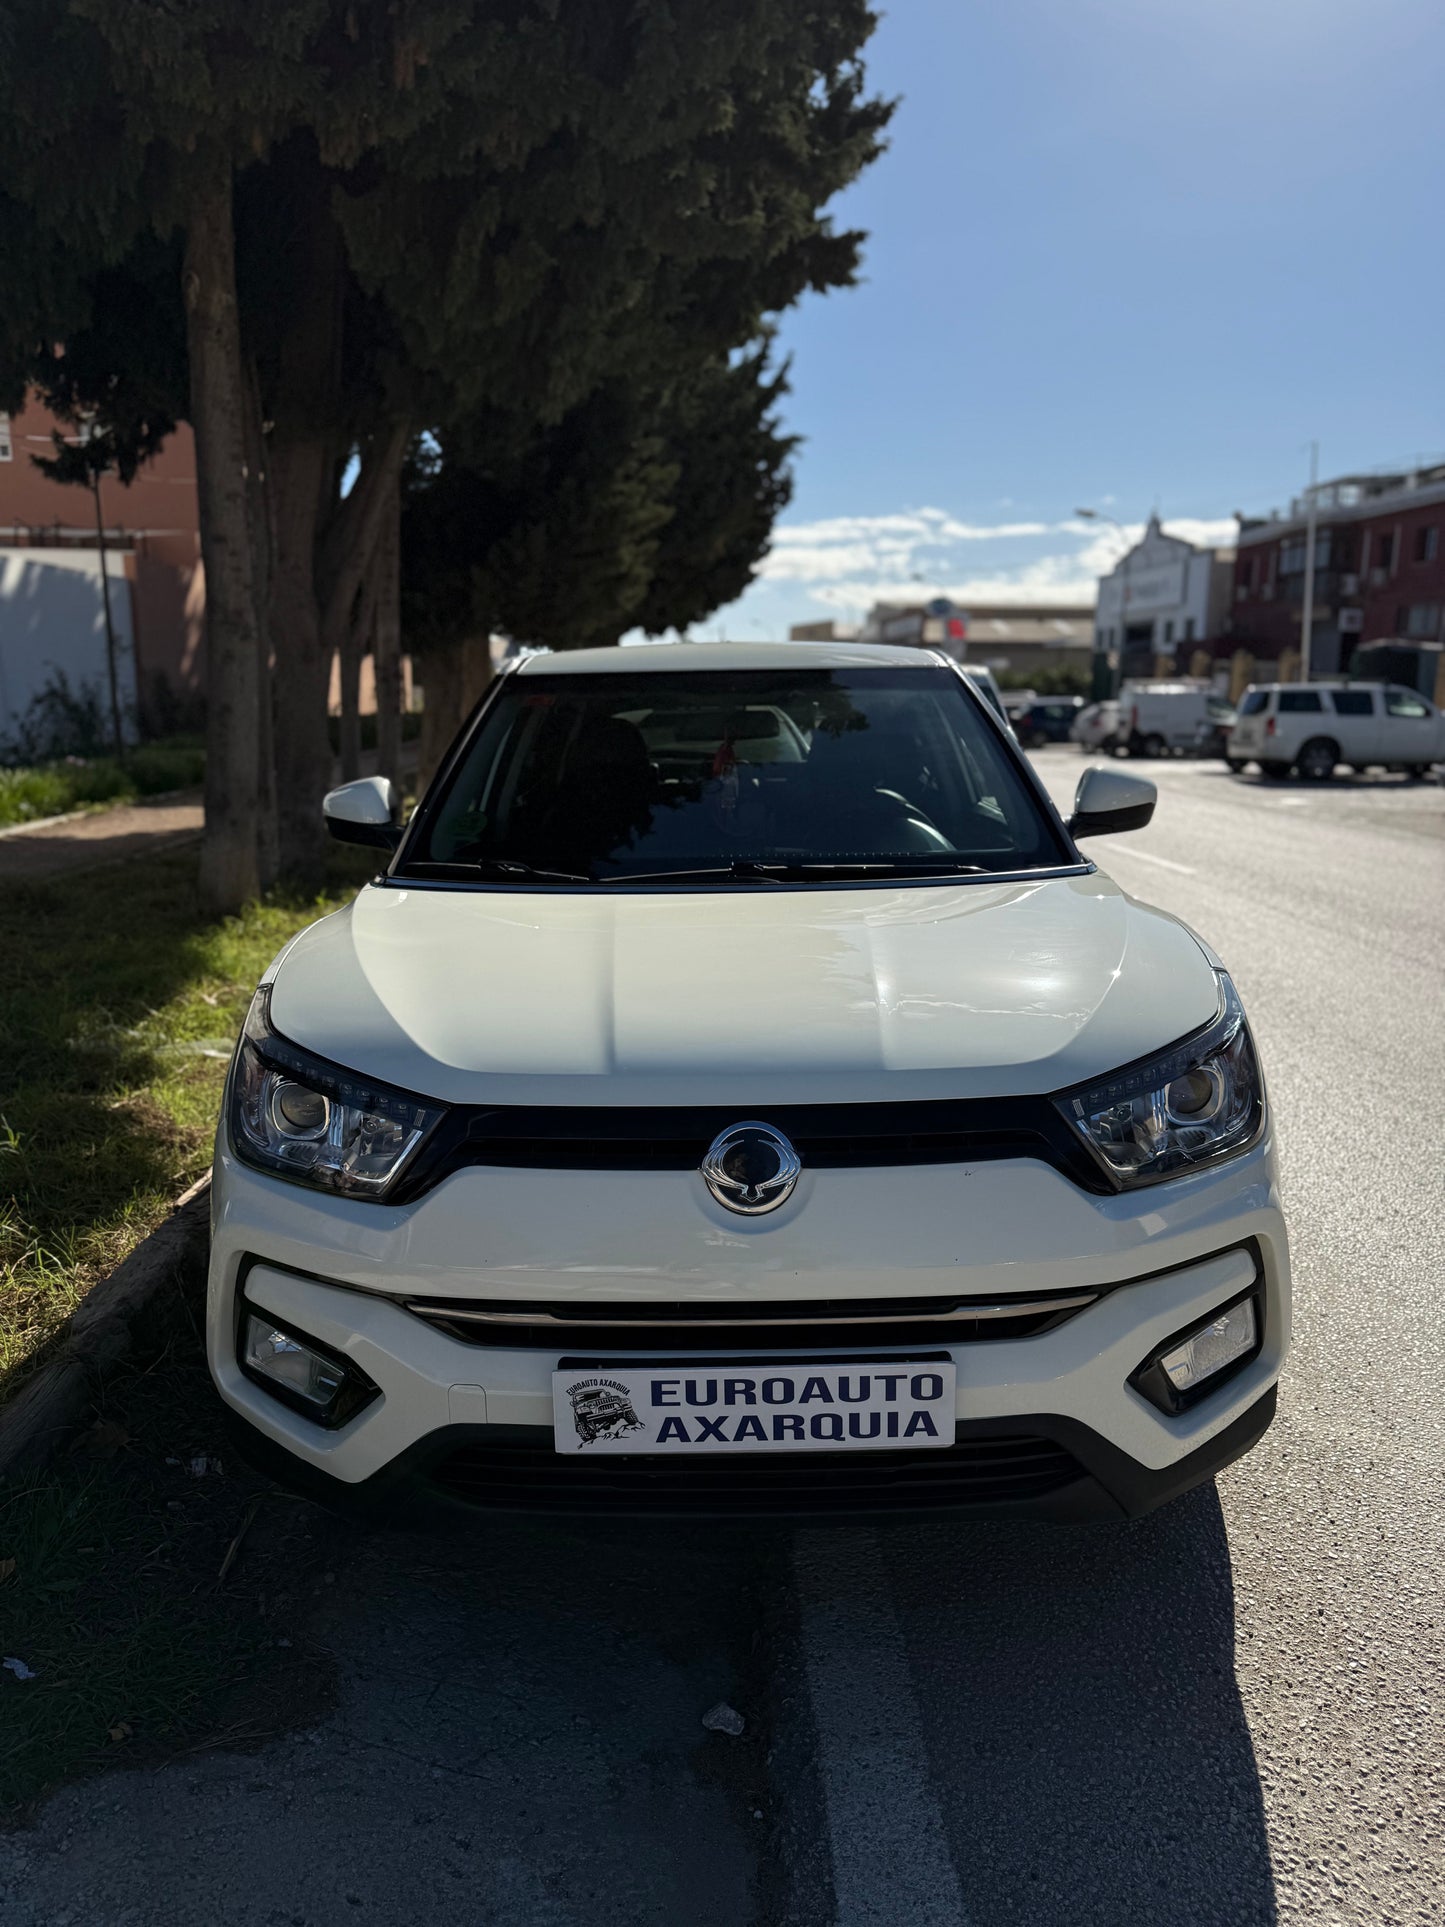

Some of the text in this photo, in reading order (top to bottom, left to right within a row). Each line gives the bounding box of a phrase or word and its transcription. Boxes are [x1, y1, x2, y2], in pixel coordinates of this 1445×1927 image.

[565, 1379, 631, 1397] EUROAUTO AXARQUIA
[650, 1374, 944, 1406] EUROAUTO
[655, 1410, 939, 1442] AXARQUIA
